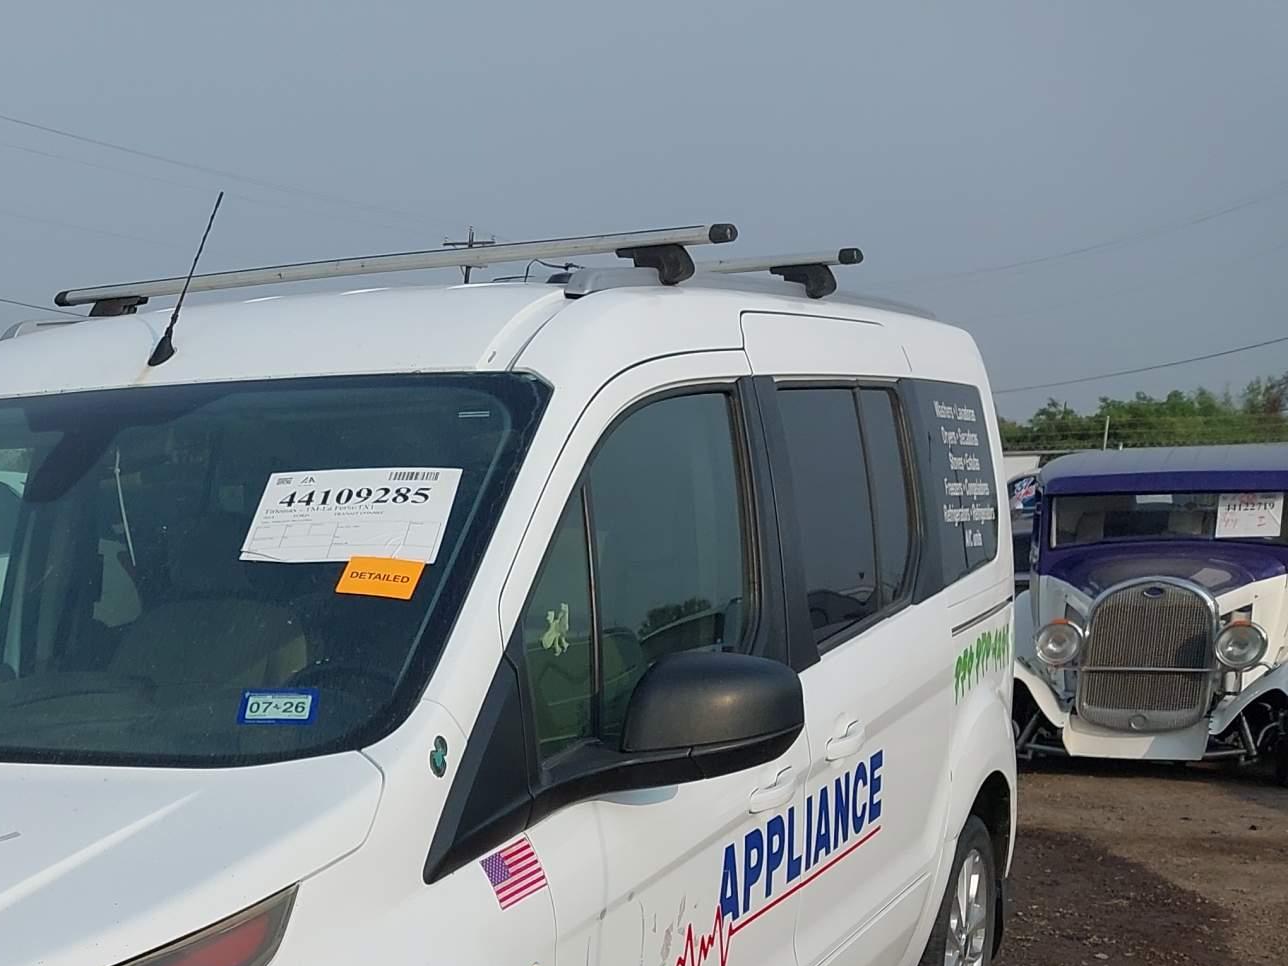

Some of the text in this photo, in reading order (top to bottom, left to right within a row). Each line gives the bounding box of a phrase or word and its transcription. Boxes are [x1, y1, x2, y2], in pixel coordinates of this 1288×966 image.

[279, 487, 432, 507] 44109285
[350, 571, 410, 584] DETAILED
[720, 750, 883, 922] APPLIANCE
